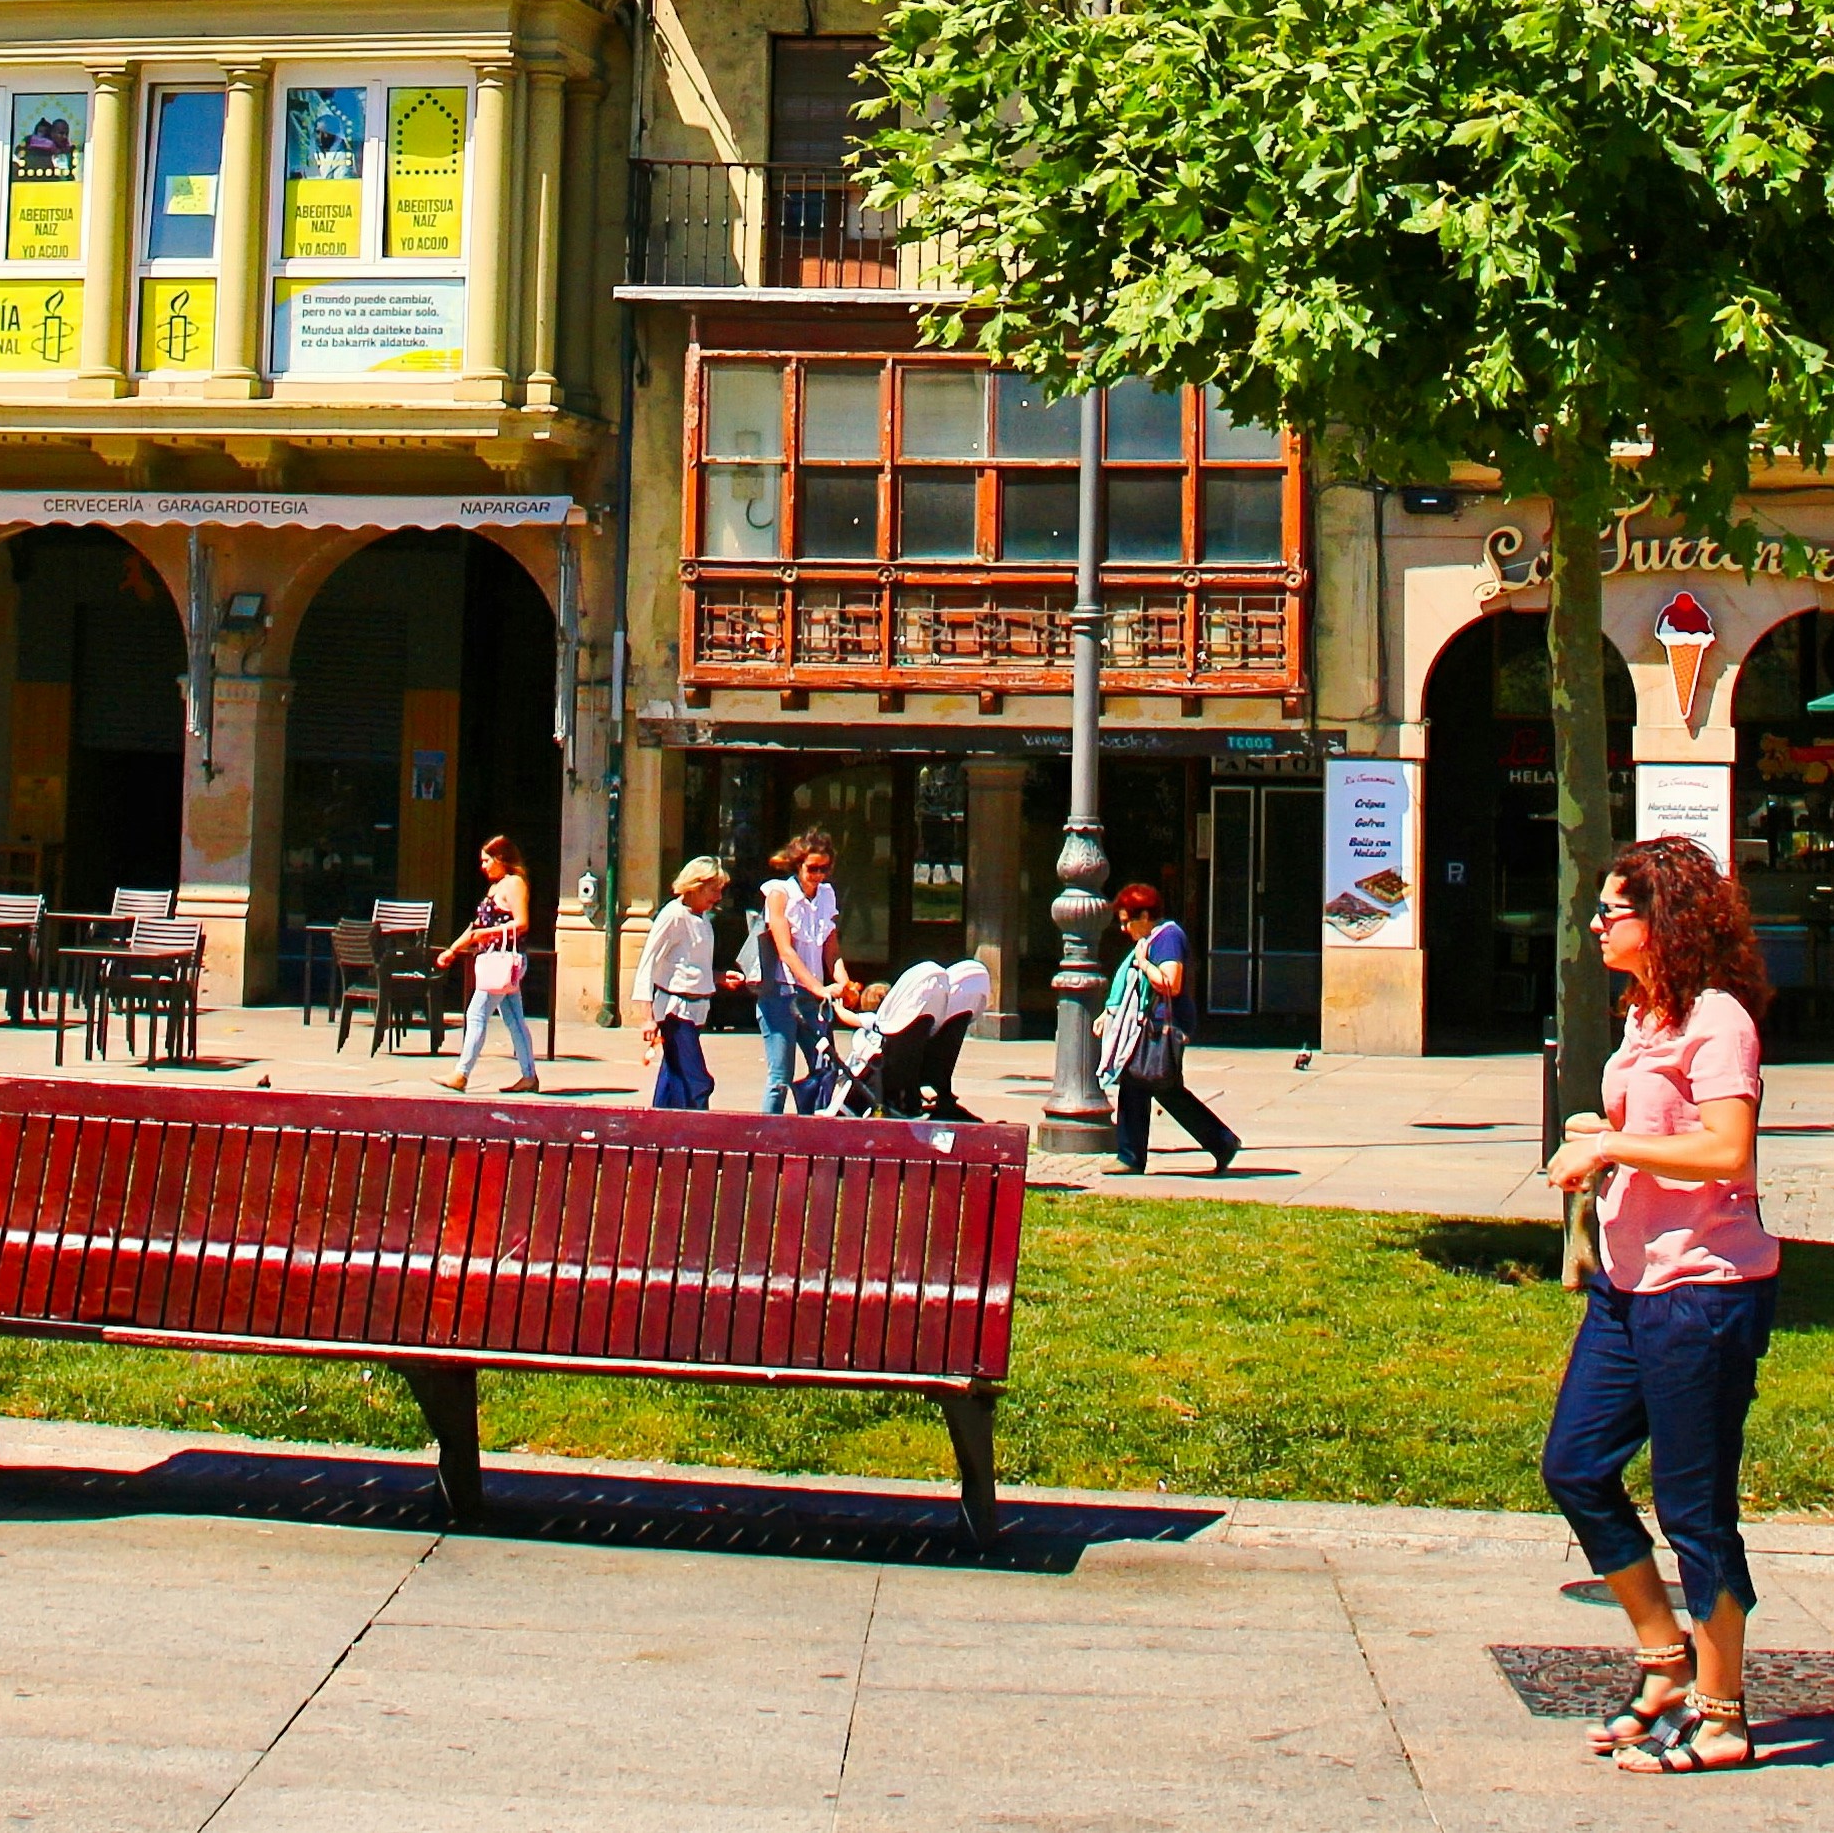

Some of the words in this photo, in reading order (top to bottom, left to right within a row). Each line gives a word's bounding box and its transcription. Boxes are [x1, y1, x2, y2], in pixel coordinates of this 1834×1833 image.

[295, 204, 352, 218] ABEGITSUA
[396, 199, 454, 213] ABEGITSUA
[19, 207, 74, 221] ABEGITSUA
[413, 214, 437, 227] NAIZ
[35, 223, 59, 235] NAIZ
[311, 220, 335, 233] NAIZ
[298, 242, 312, 255] YO
[315, 242, 347, 255] ACOJO
[401, 237, 414, 250] YO
[416, 236, 449, 250] ACOJO
[22, 245, 35, 258] YO
[38, 245, 69, 258] ACOJO
[302, 294, 312, 304] El
[315, 294, 351, 304] mundo
[354, 294, 387, 306] puede
[389, 294, 434, 305] cambiar,
[302, 308, 326, 318] pero
[328, 308, 342, 317] no
[345, 308, 357, 317] va
[360, 309, 366, 317] a
[369, 306, 412, 317] cambiar
[415, 306, 440, 317] solo.
[301, 325, 344, 335] Mundua
[347, 325, 370, 335] alda
[373, 325, 412, 335] daiteke
[414, 325, 444, 335] baina
[301, 339, 313, 347] ez
[316, 337, 329, 347] da
[331, 338, 377, 347] bakarrik
[380, 338, 429, 347] aldatuko.
[43, 496, 144, 513] CERVECERÍA
[157, 498, 309, 514] GARAGARDOTEGIA
[460, 501, 551, 515] NAPARGAR
